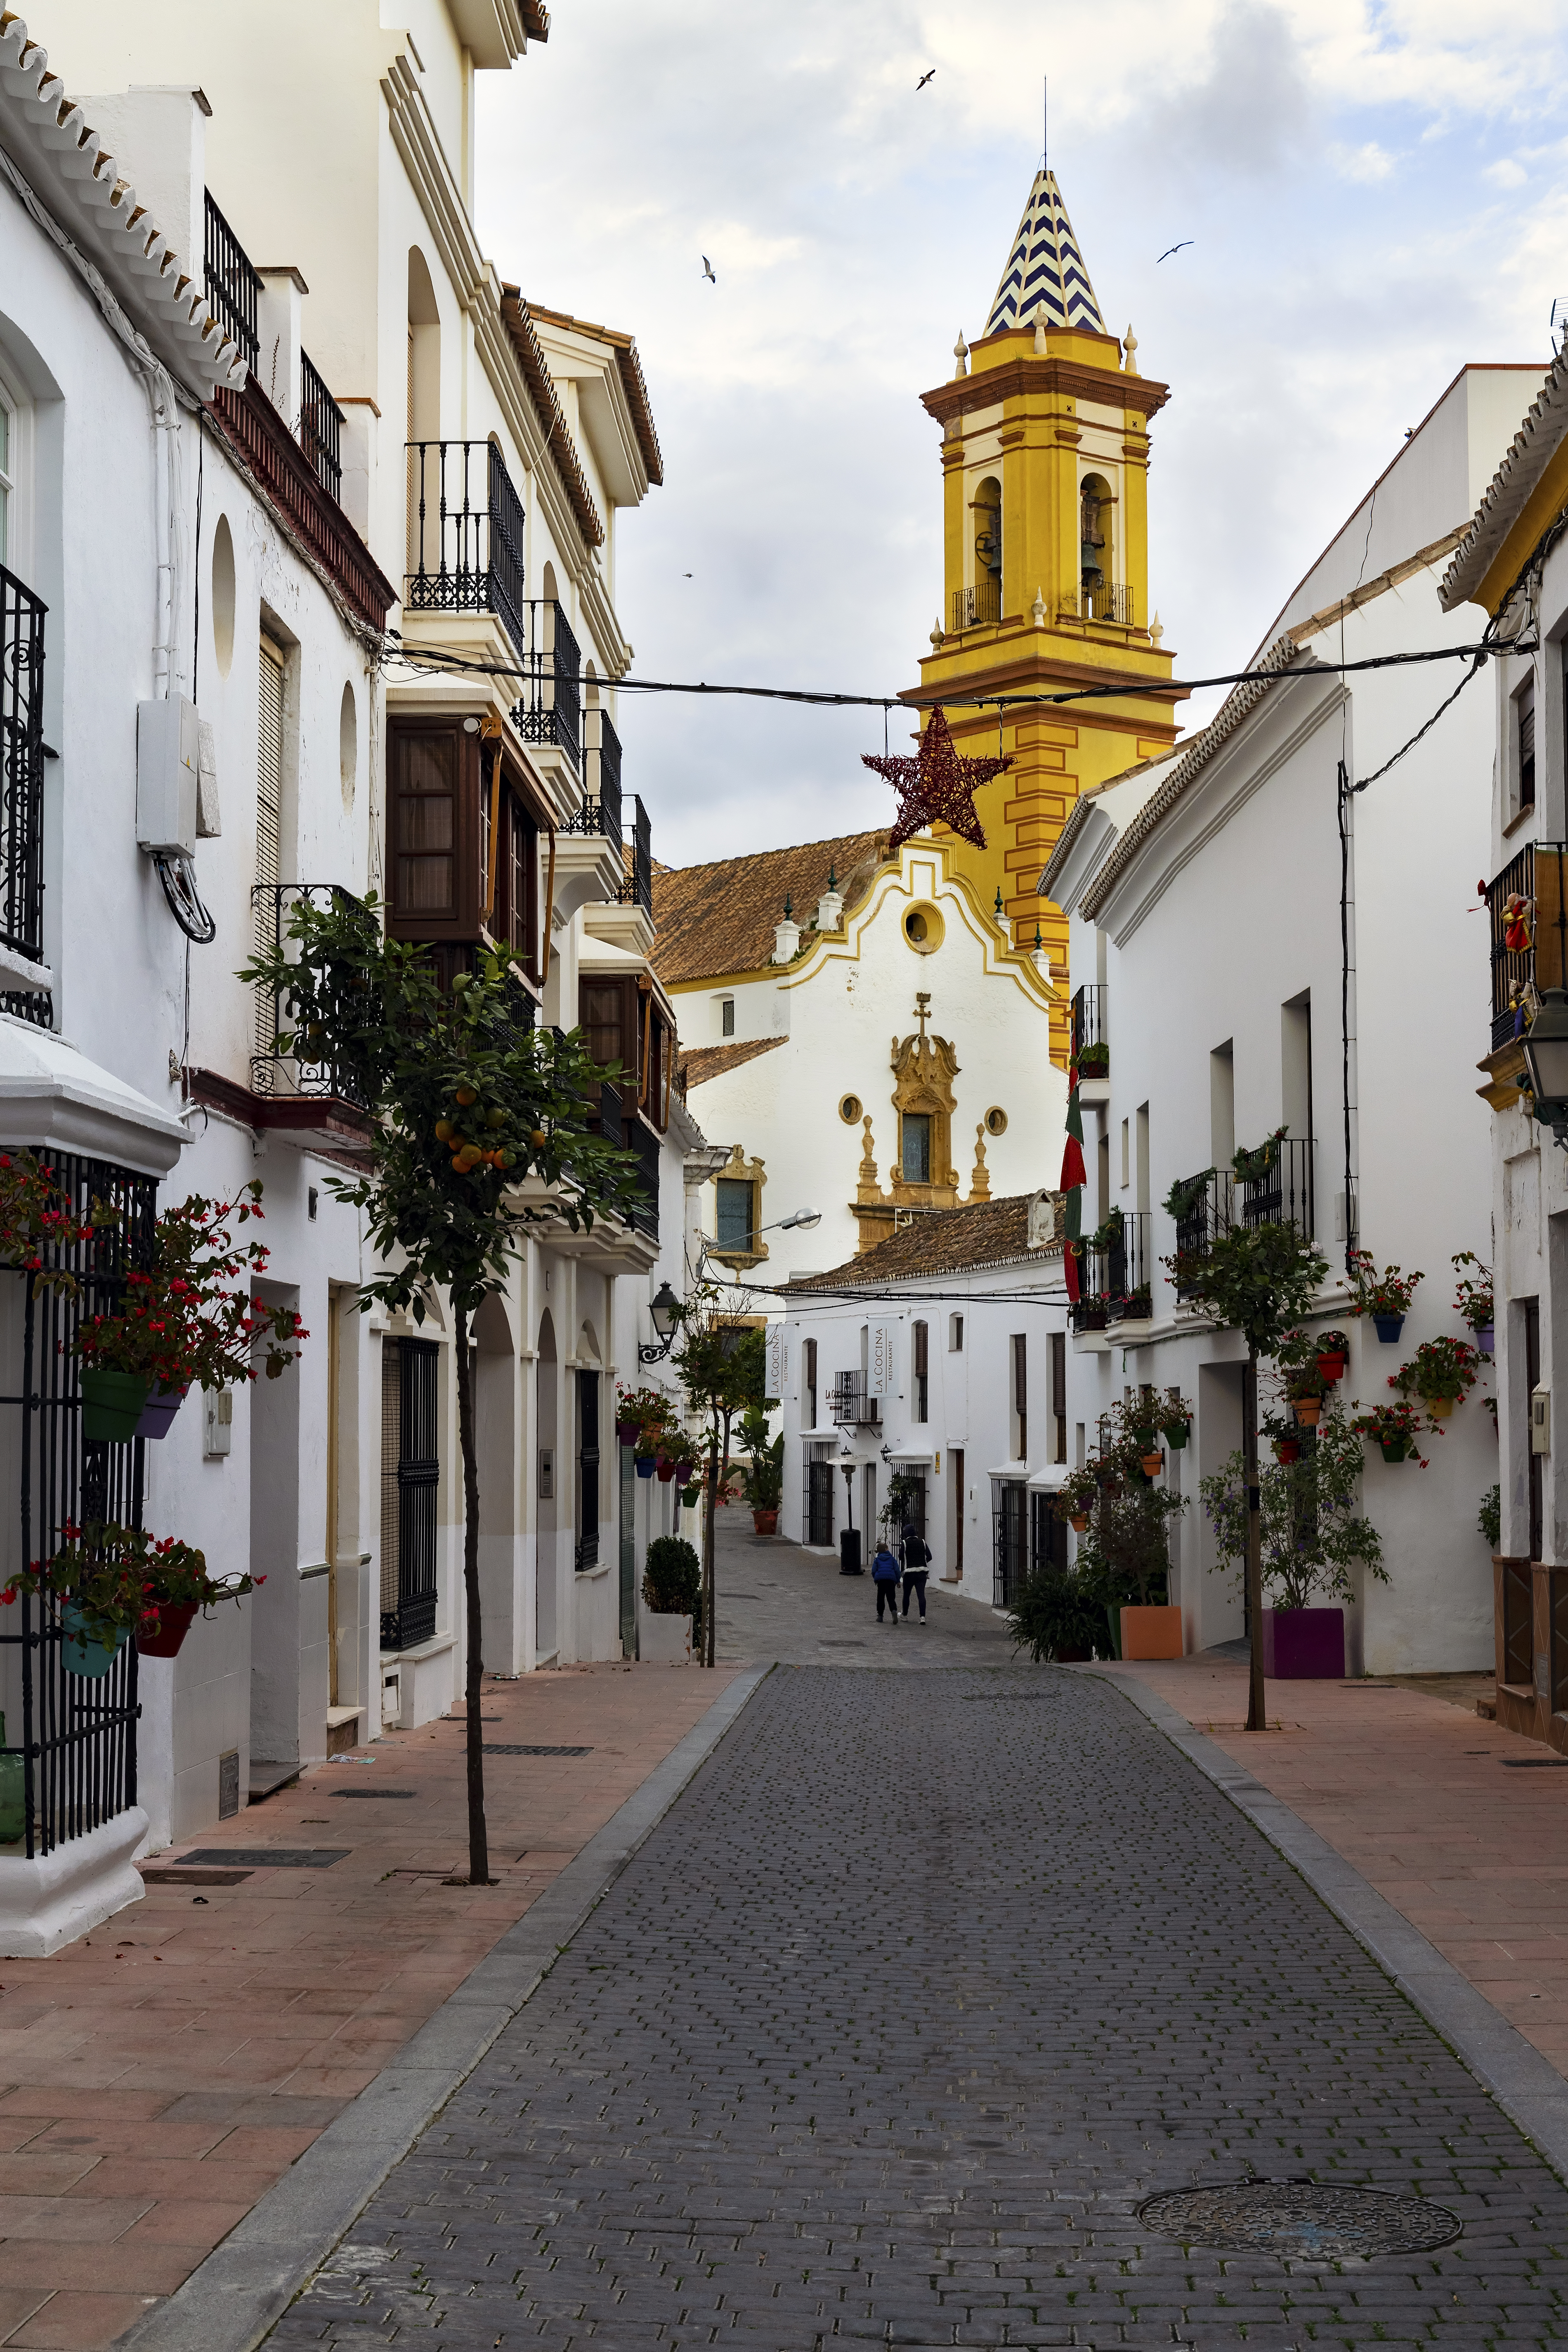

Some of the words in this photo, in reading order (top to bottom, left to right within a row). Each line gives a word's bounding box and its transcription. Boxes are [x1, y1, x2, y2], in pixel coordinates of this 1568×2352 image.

[874, 1328, 883, 1375] COCINA
[771, 1381, 779, 1393] LA
[874, 1379, 883, 1393] LA
[826, 1390, 831, 1399] LA
[1244, 2196, 1354, 2205] SANEAMIENTO
